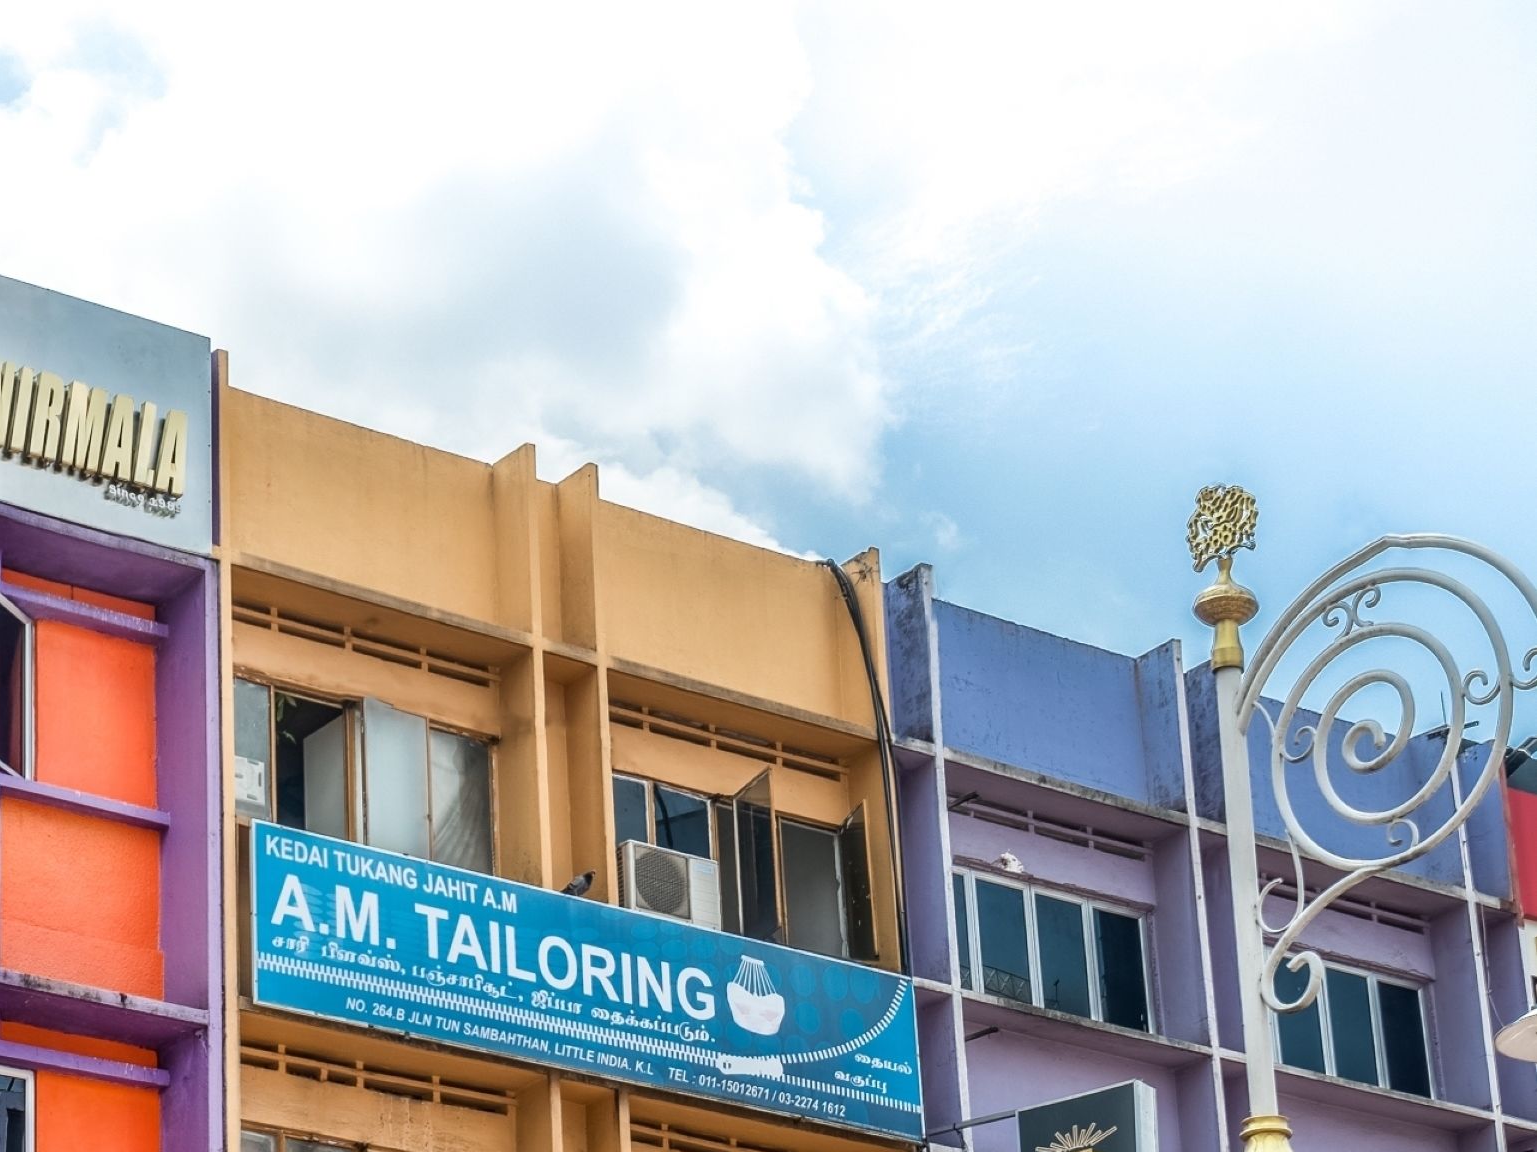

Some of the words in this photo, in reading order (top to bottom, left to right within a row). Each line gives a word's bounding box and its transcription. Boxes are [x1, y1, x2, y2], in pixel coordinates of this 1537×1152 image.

[266, 834, 328, 869] KEDAI
[333, 851, 417, 889] TUKANG
[423, 873, 478, 904] JAHIT
[483, 887, 518, 914] A.M
[271, 873, 396, 950] A.M.
[414, 902, 716, 1021] TAILORING
[345, 996, 368, 1014] NO.
[372, 1002, 405, 1022] 264.B
[408, 1010, 432, 1028] JLN
[435, 1014, 460, 1034] TUN
[555, 1041, 595, 1063] LITTLE
[597, 1051, 632, 1072] INDIA.
[635, 1060, 654, 1076] K.L
[668, 1067, 689, 1083] TEL
[699, 1074, 770, 1102] 011-15012671
[779, 1091, 819, 1112] 03-2274
[822, 1101, 846, 1118] 1612
